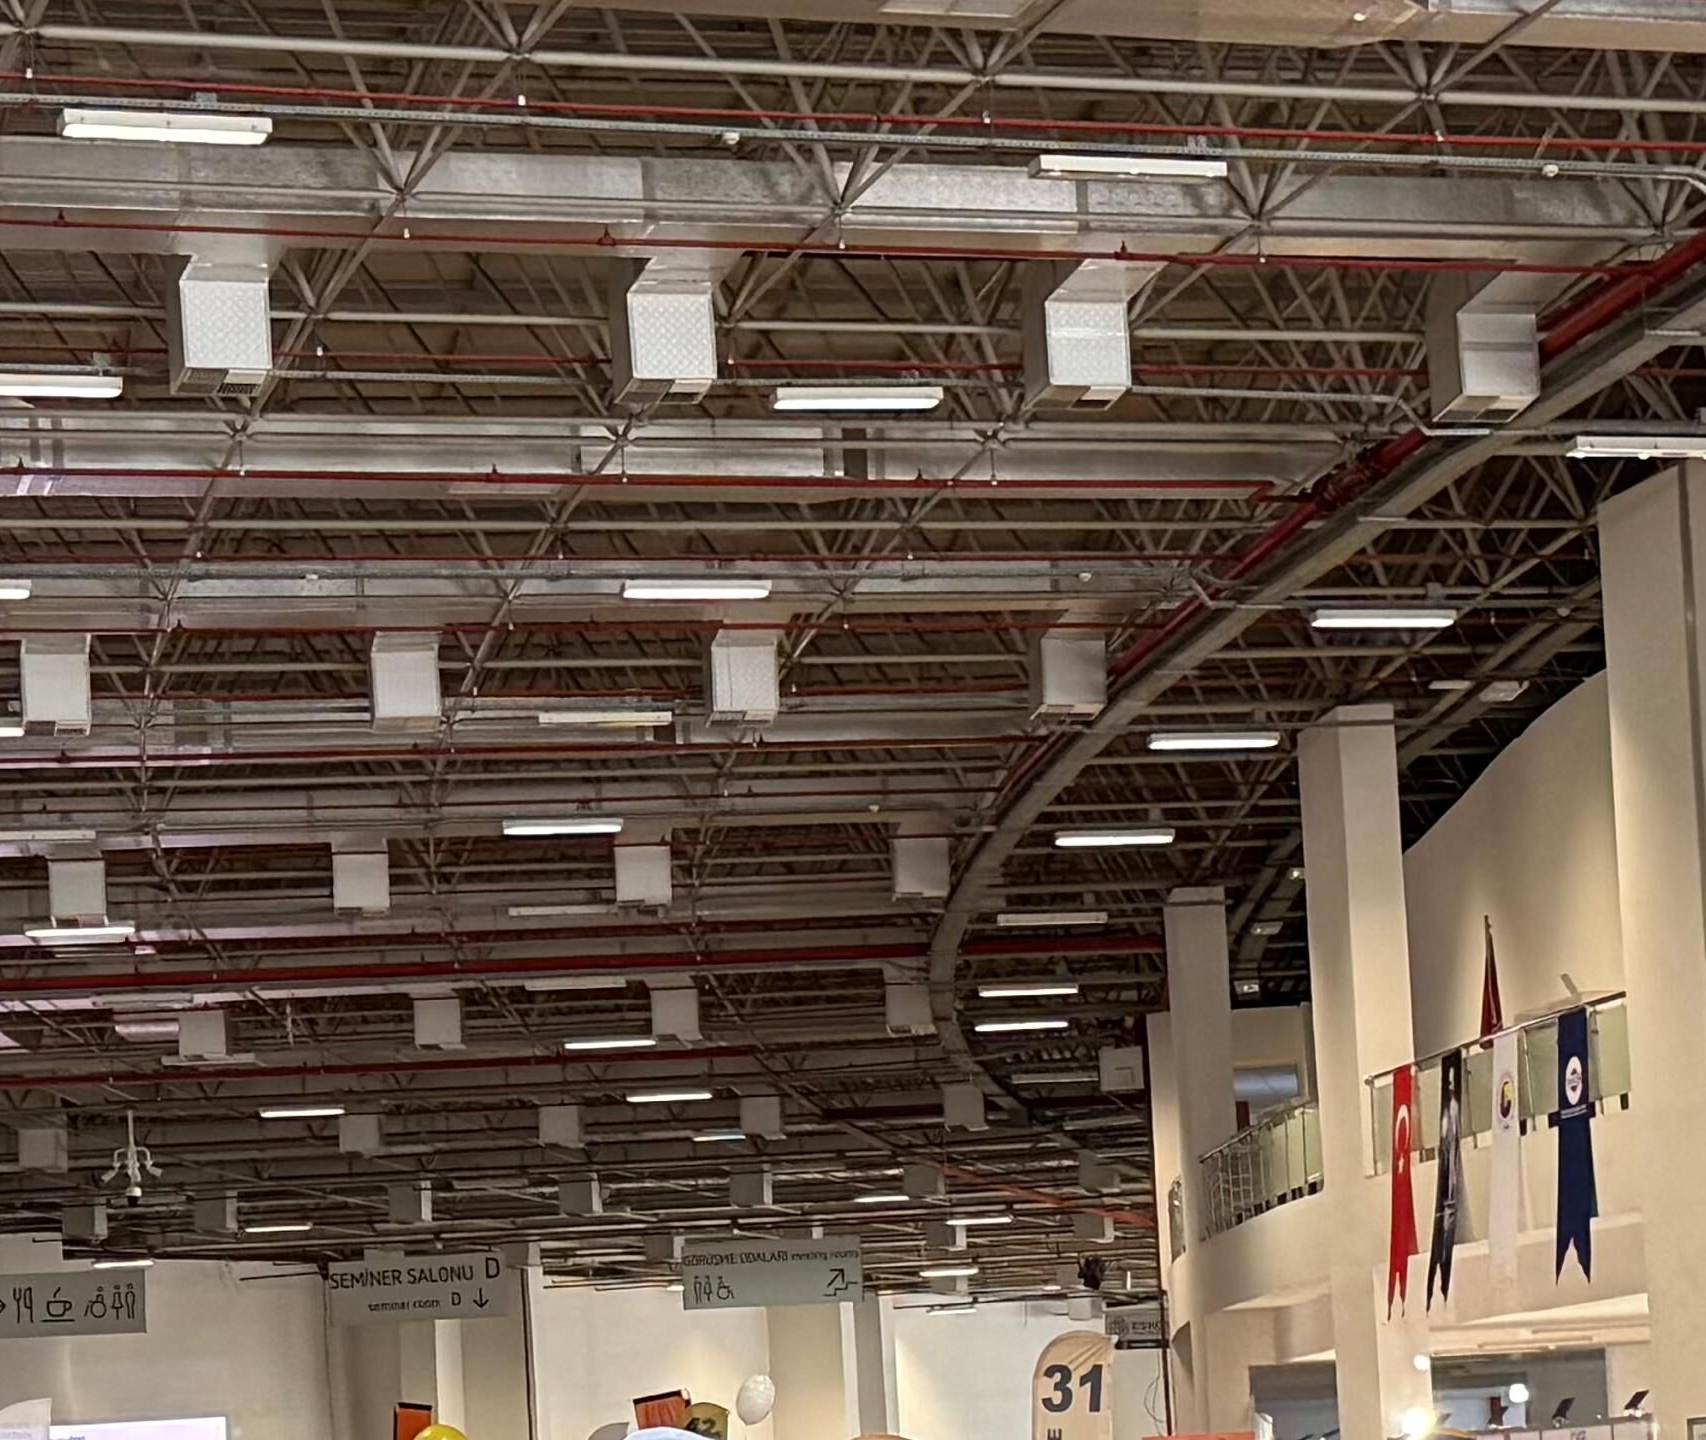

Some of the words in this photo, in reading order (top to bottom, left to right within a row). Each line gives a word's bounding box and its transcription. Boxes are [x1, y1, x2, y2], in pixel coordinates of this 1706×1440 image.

[329, 1269, 403, 1290] SEMİNER
[406, 1265, 474, 1285] SALONU
[484, 1256, 501, 1279] D
[451, 1291, 462, 1307] D
[1041, 1364, 1104, 1413] 31
